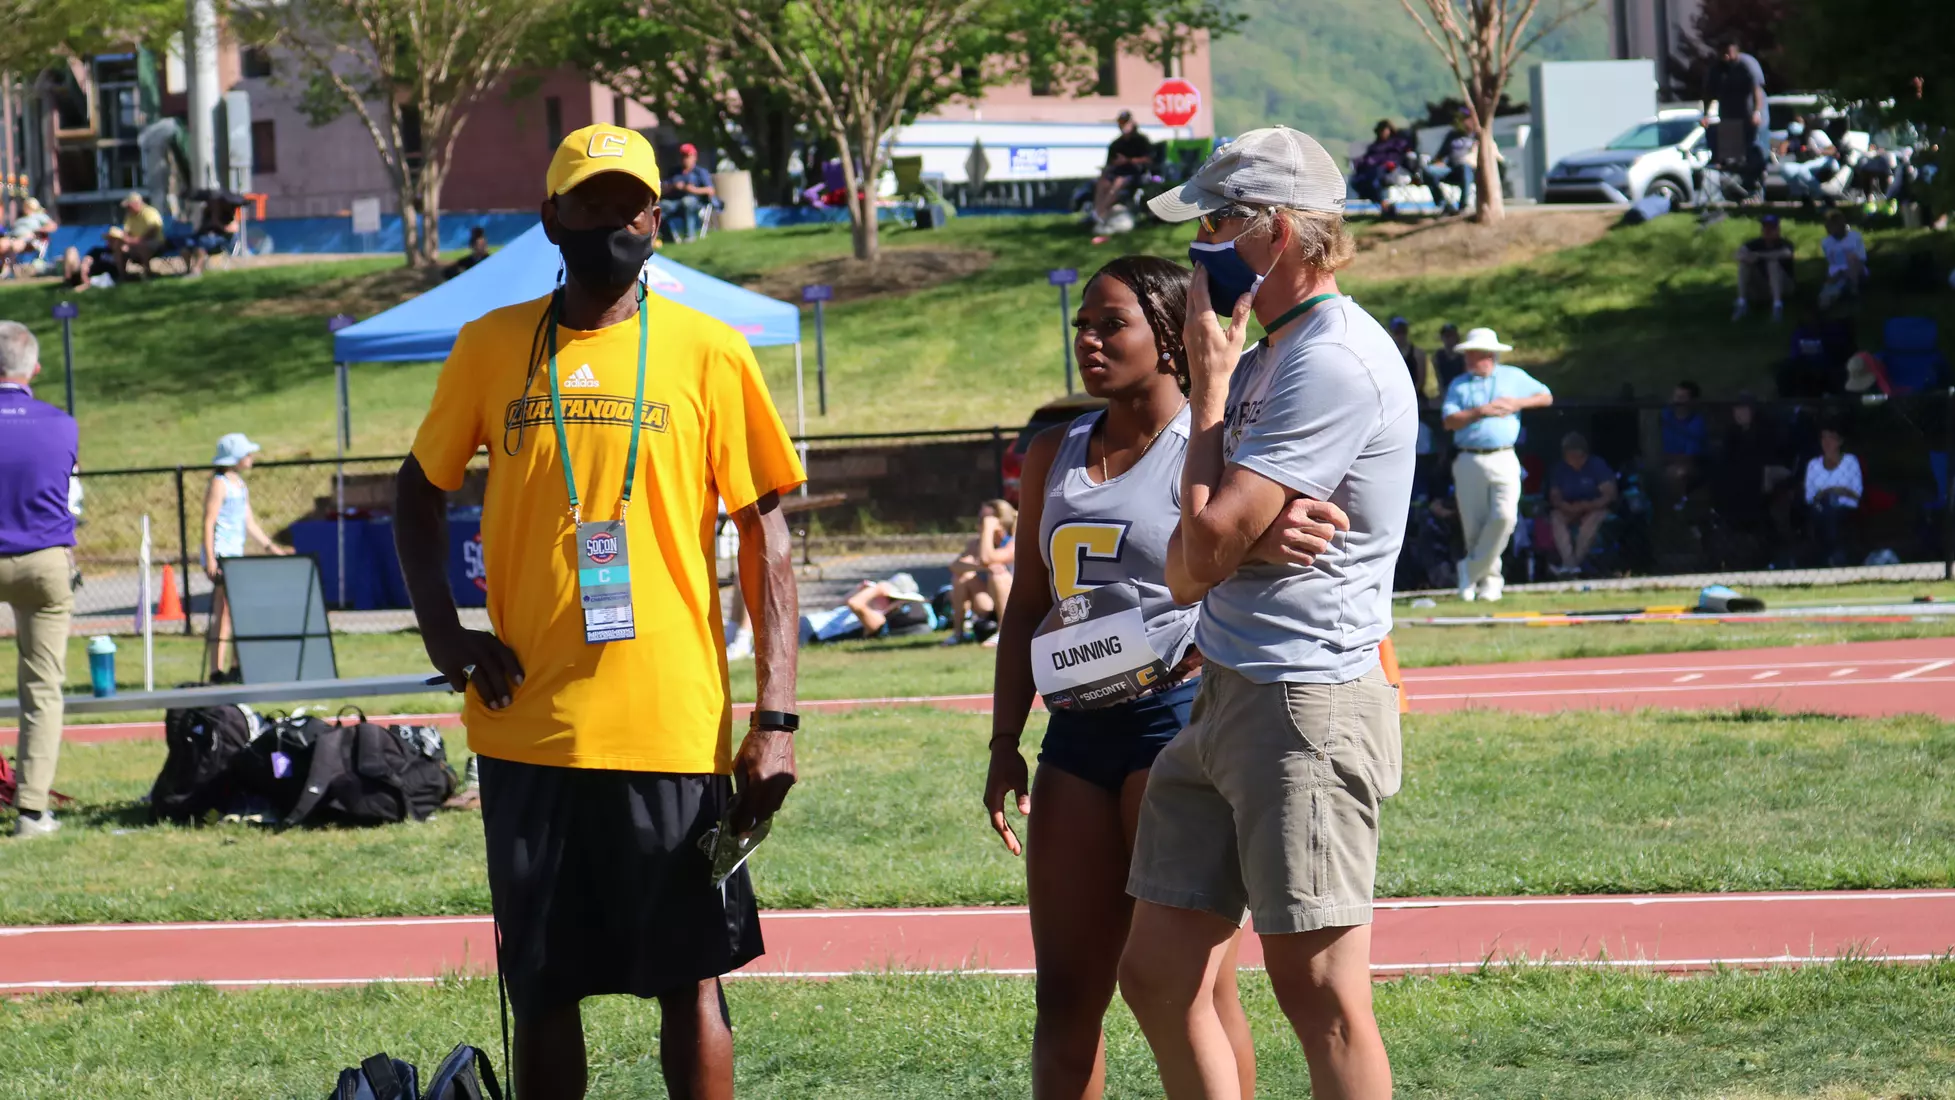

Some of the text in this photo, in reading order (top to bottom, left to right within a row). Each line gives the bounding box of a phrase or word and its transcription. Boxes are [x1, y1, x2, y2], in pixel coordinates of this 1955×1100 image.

[1155, 93, 1197, 115] STOP
[588, 132, 627, 158] C
[564, 378, 600, 388] adidas
[586, 536, 618, 557] SOCON
[1048, 517, 1134, 602] C
[598, 568, 611, 583] C
[1051, 635, 1122, 671] DUNNING
[1135, 665, 1159, 687] C
